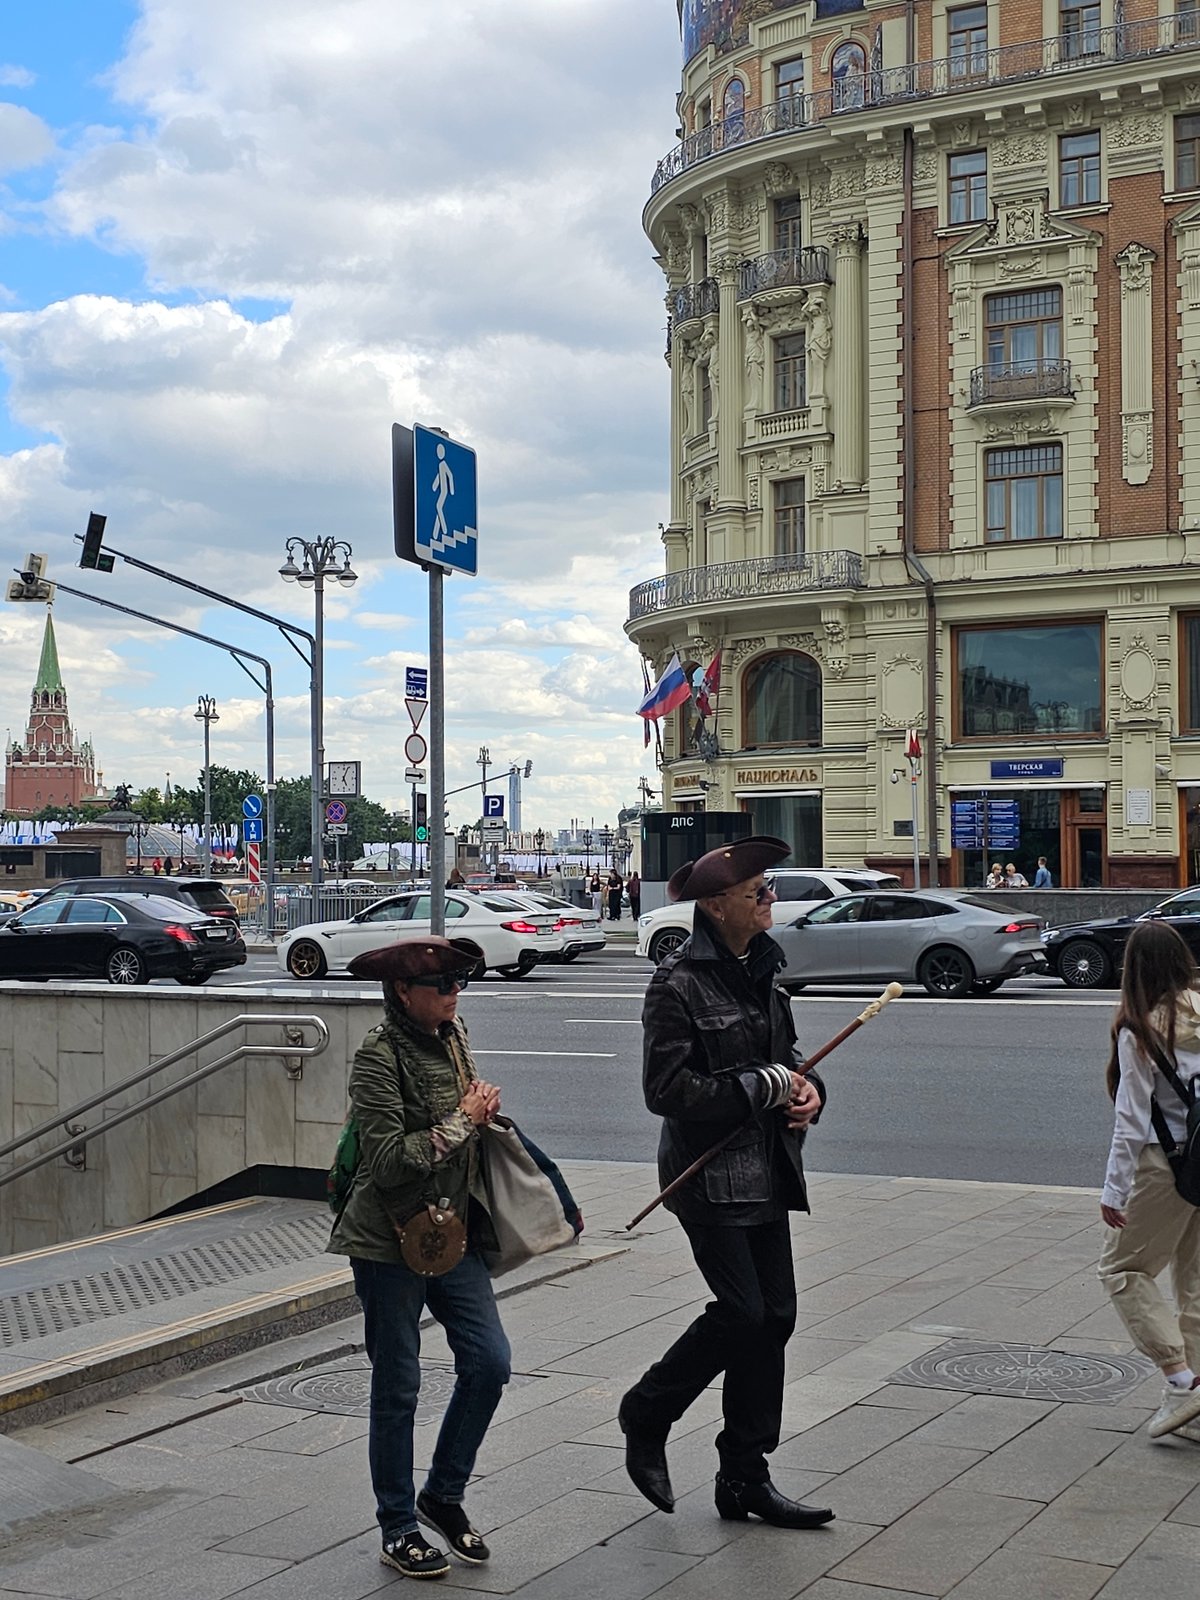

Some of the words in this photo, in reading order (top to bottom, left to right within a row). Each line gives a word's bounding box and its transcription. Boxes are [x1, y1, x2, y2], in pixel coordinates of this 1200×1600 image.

[1009, 763, 1043, 771] ТВЕРСКАЯ
[737, 768, 818, 784] НАЦИОНАЛЬ
[488, 798, 500, 815] P
[671, 816, 694, 828] ДПС
